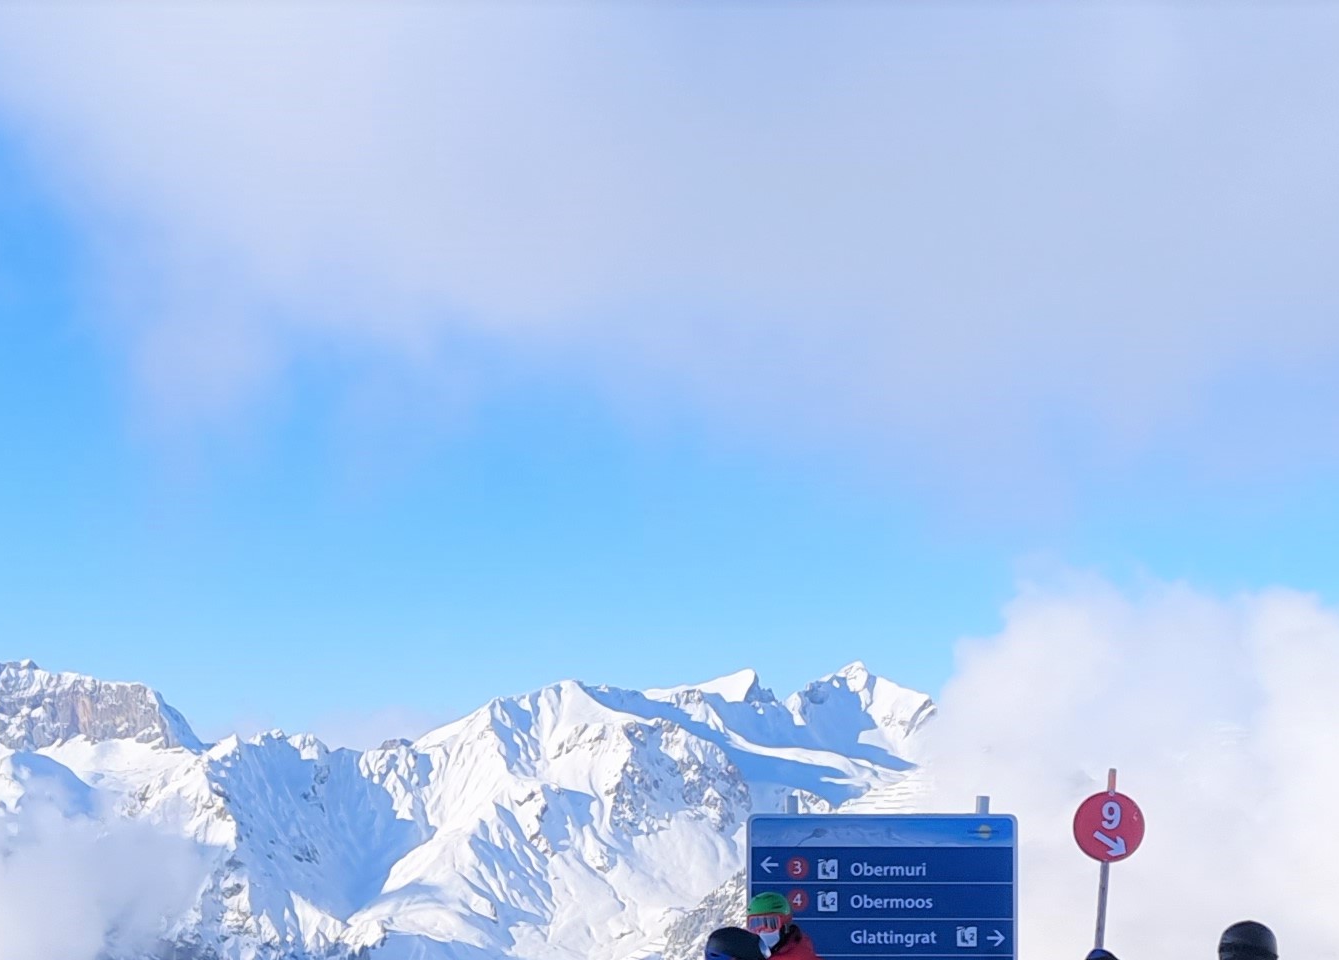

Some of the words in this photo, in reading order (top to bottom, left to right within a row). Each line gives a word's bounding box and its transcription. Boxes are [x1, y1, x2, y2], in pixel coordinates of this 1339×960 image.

[1101, 801, 1122, 830] 9
[792, 860, 802, 875] 3
[850, 862, 927, 877] Obermuri
[792, 893, 802, 907] 4
[850, 894, 934, 909] Obermoos
[850, 929, 937, 948] Glattingrat
